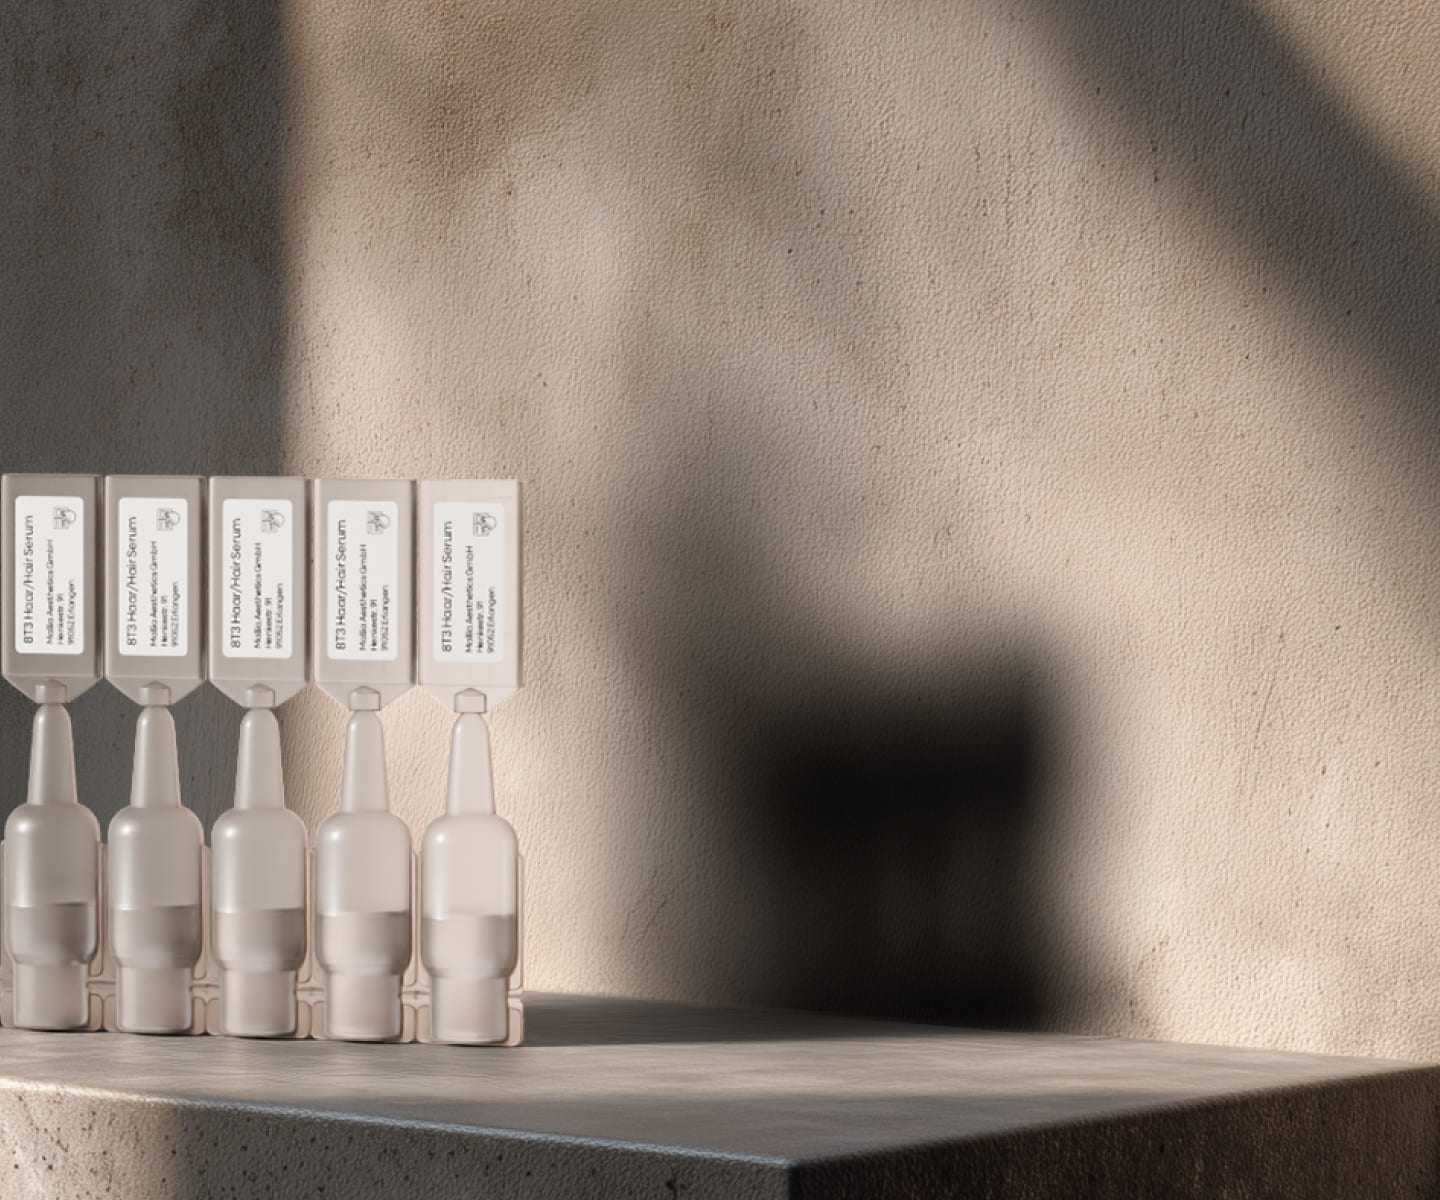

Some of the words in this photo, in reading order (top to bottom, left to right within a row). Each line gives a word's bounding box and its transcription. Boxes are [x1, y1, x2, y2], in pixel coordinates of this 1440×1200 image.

[23, 515, 34, 556] Serum
[126, 517, 138, 557] Serum
[230, 518, 242, 559] Serum
[335, 520, 348, 561] Serum
[440, 521, 453, 563] Serum
[22, 558, 35, 619] Haar/Hair
[45, 570, 55, 616] Aesthetics
[125, 559, 139, 622] Haar/Hair
[149, 572, 159, 618] Aesthetics
[229, 561, 243, 624] Haar/Hair
[253, 573, 262, 620] Aesthetics
[335, 562, 349, 626] Haar/Hair
[359, 575, 368, 622] Aesthetics
[440, 564, 454, 628] Haar/Hair
[464, 576, 474, 624] Aesthetics
[23, 622, 34, 644] 8T3
[126, 624, 138, 645] 8T3
[230, 626, 242, 648] 8T3
[335, 628, 347, 650] 8T3
[440, 630, 453, 652] 8T3
